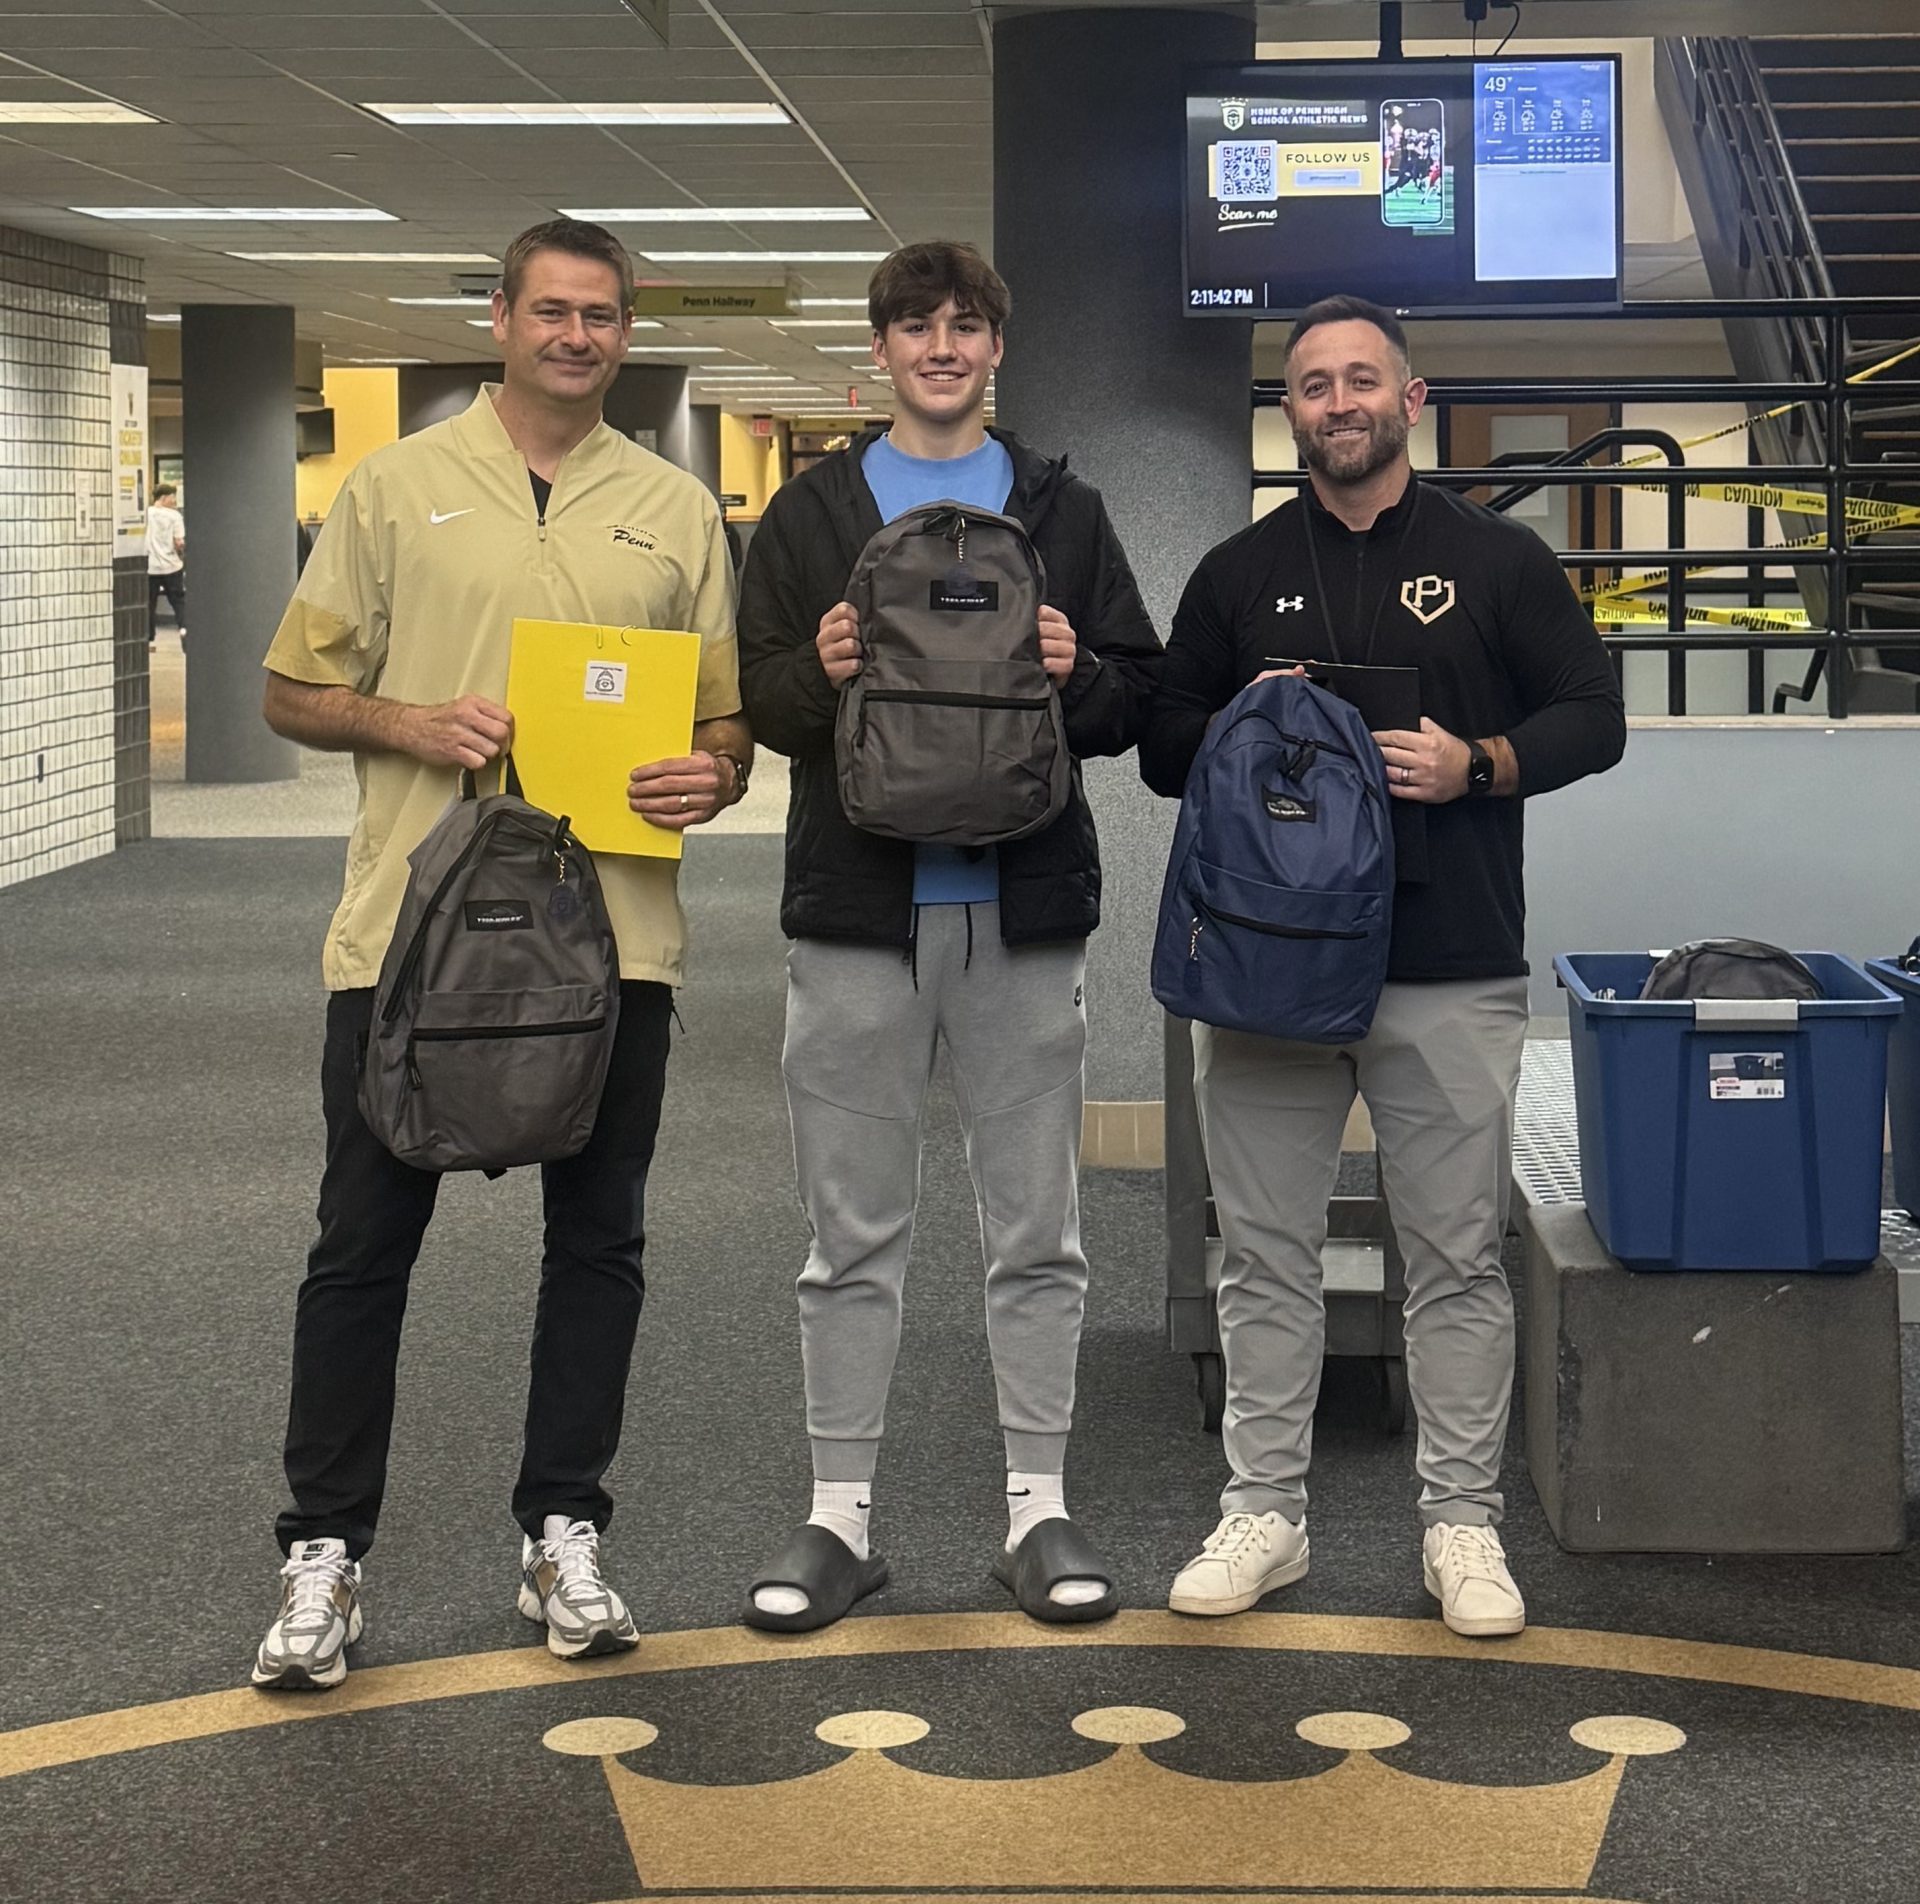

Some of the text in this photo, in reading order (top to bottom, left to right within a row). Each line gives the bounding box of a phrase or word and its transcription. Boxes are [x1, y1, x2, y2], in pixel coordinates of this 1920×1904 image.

[1251, 107, 1278, 115] HOME
[1280, 107, 1293, 115] OF
[1251, 115, 1368, 125] SCHOOL ATHLETIC NEWS
[1286, 152, 1370, 163] FOLLOW US
[1218, 203, 1278, 221] Scan me
[683, 296, 756, 308] Penn Hallway
[1190, 288, 1253, 305] 2:11:42 PM
[613, 530, 656, 550] Penn
